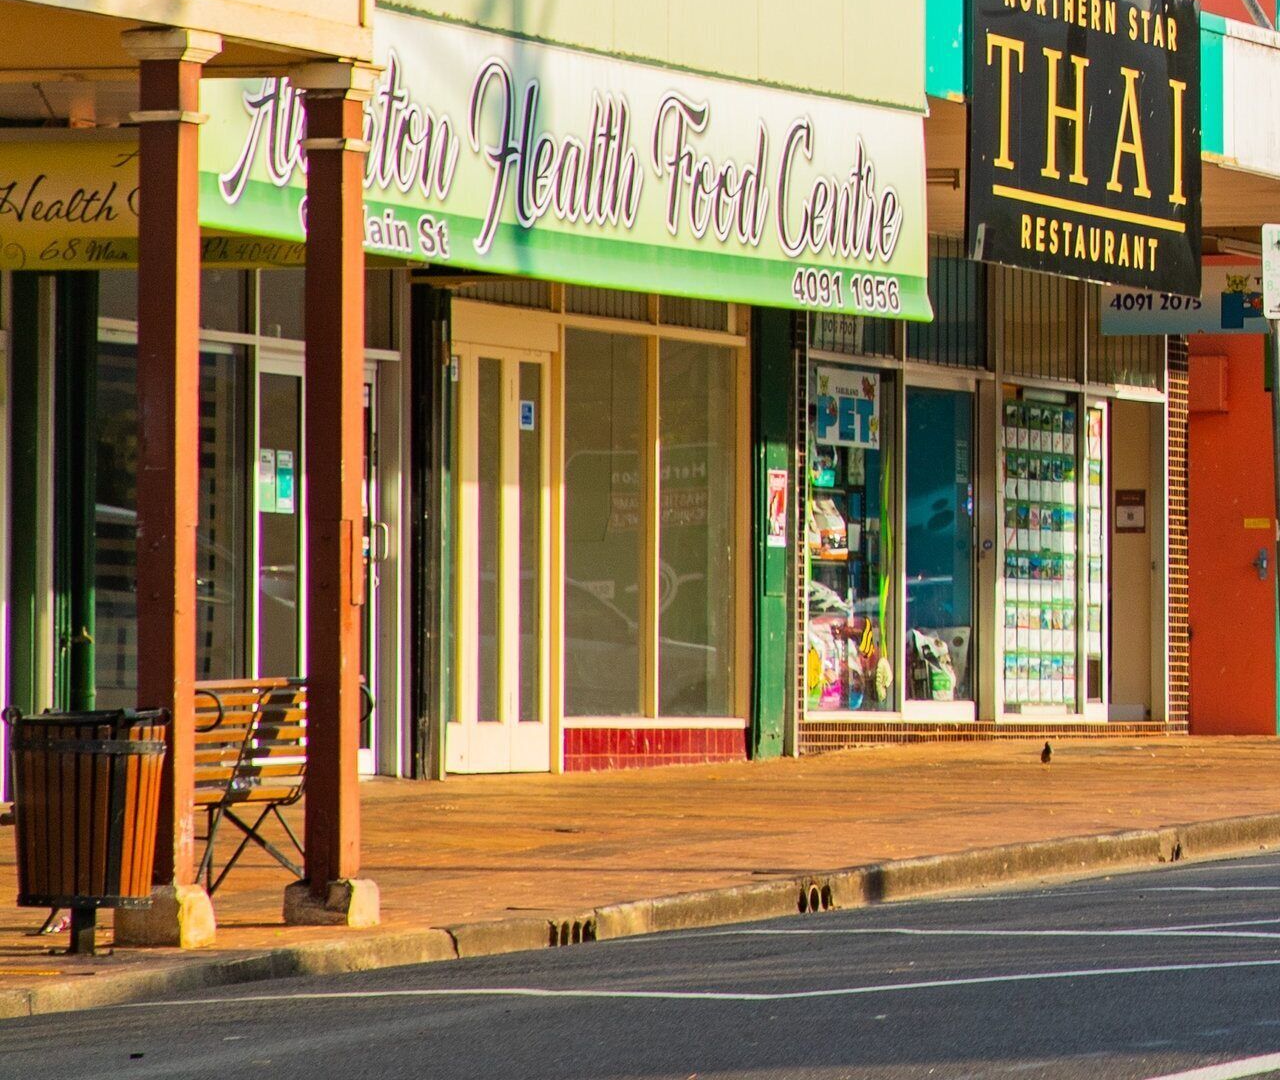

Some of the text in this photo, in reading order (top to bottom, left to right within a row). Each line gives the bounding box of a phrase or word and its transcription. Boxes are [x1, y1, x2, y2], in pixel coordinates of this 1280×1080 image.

[1128, 6, 1178, 52] STAR
[986, 32, 1187, 205] THAI
[470, 54, 646, 256] Health
[651, 88, 771, 247] Food
[774, 113, 903, 263] Centre
[418, 214, 450, 260] St
[1020, 214, 1159, 272] RESTAURANT
[792, 267, 901, 314] 4091 1956
[1110, 293, 1153, 311] 4091
[818, 393, 874, 444] PET
